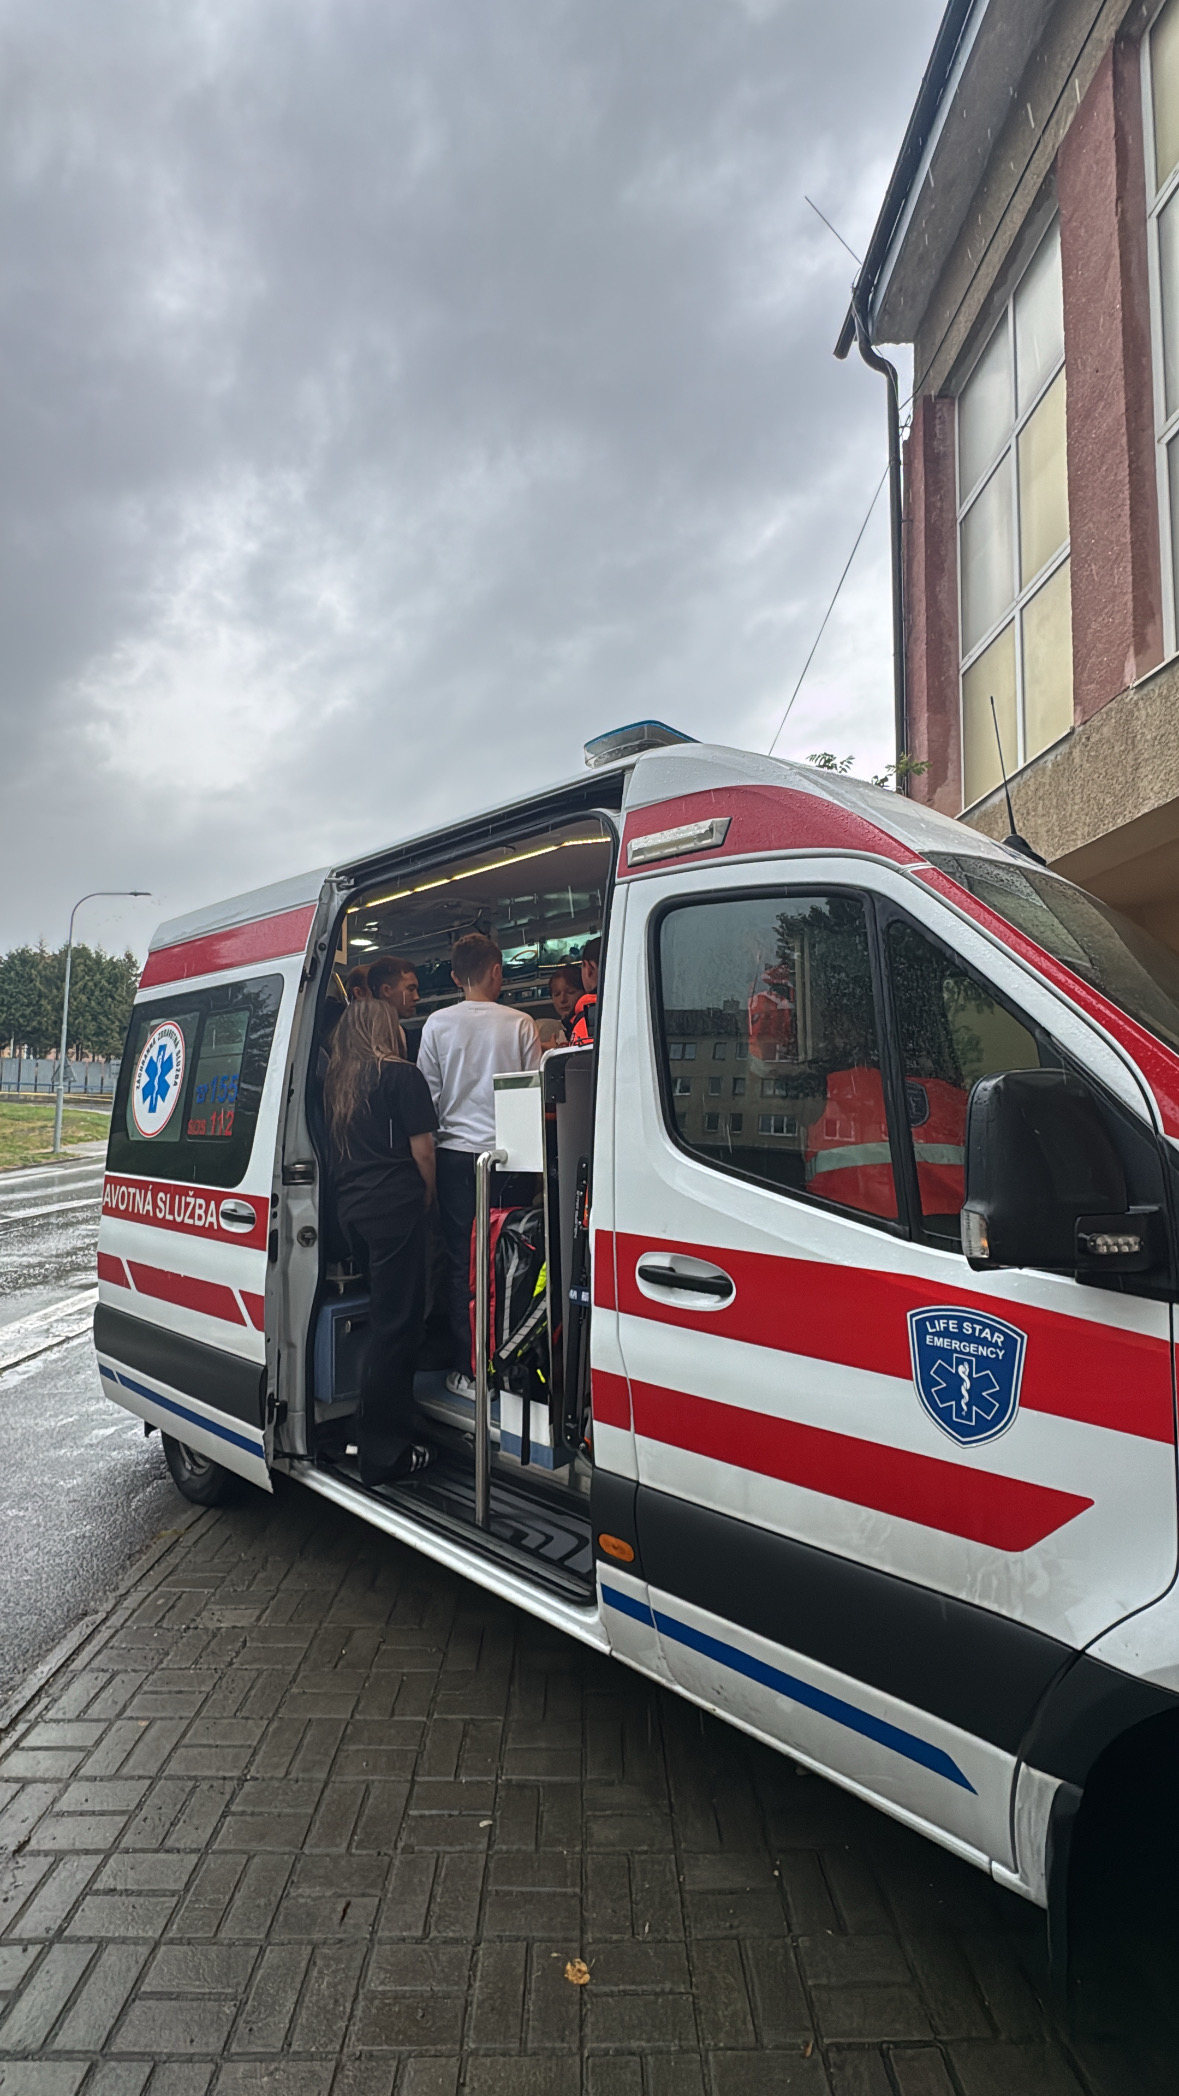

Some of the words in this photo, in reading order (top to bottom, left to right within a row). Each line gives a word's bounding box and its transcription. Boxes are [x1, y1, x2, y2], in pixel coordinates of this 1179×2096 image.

[210, 1073, 239, 1103] 155
[210, 1110, 234, 1136] 112
[156, 1190, 217, 1230] SLUŽBA
[925, 1335, 1005, 1359] EMERGENCY
[926, 1319, 959, 1333] LIFE
[962, 1321, 1005, 1347] STAR
